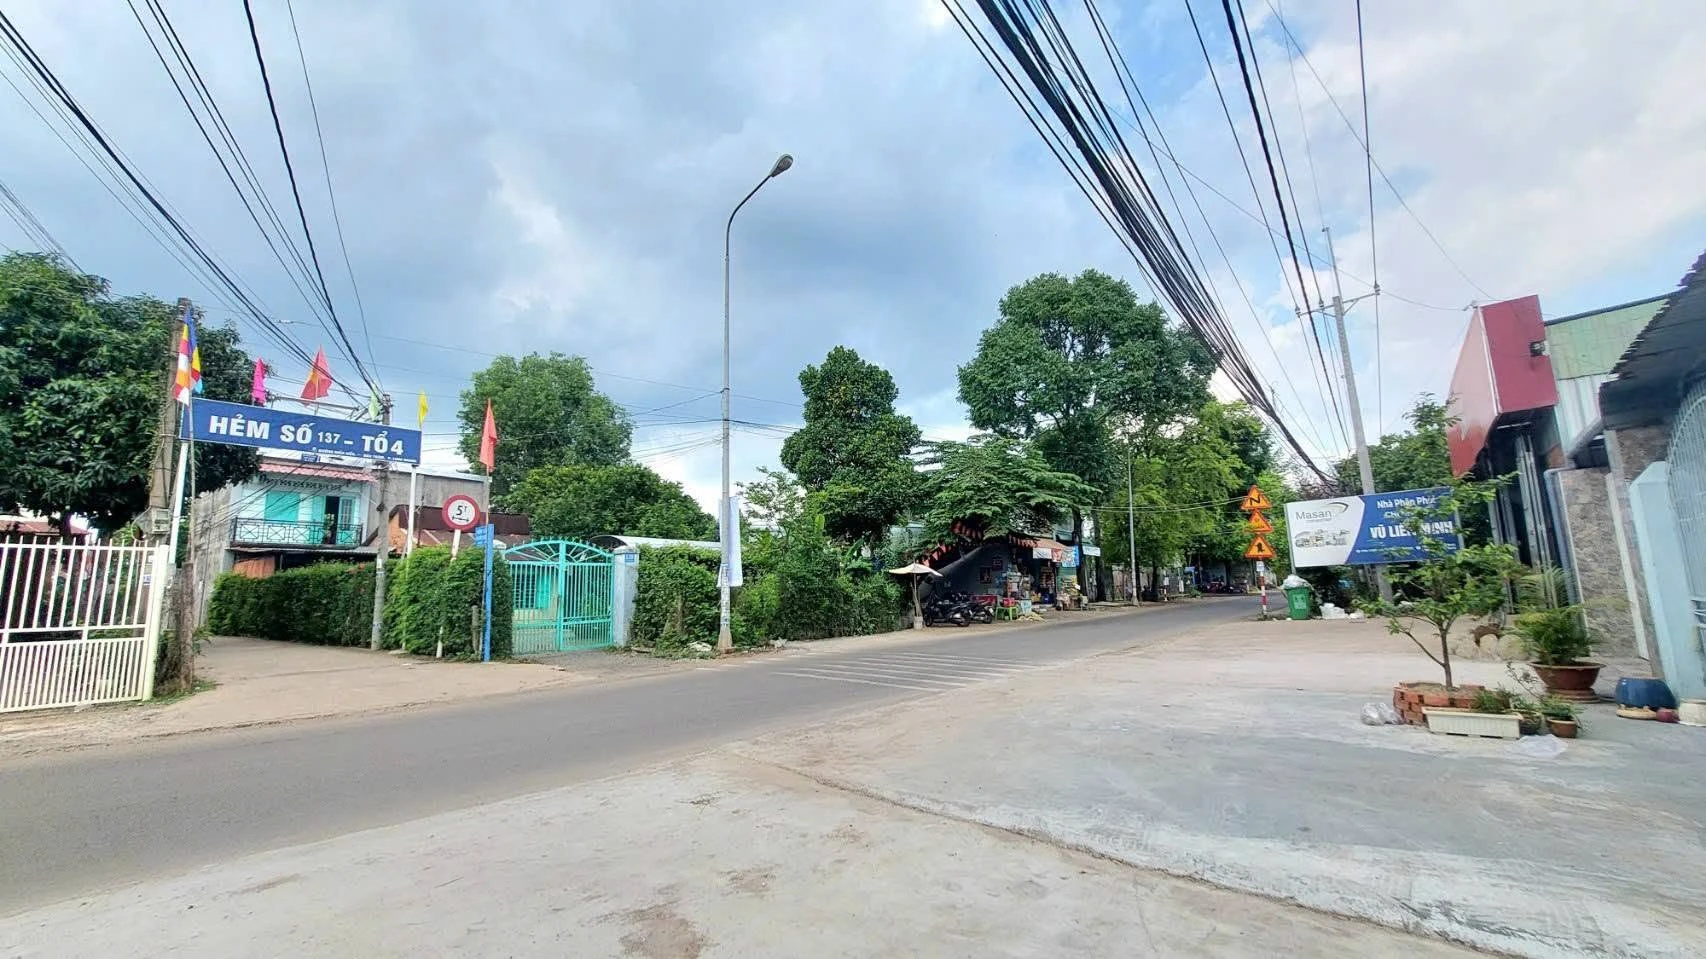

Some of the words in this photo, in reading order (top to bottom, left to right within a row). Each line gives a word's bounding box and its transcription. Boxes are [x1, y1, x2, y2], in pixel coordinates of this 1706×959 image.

[209, 413, 271, 440] HẺM
[280, 422, 315, 444] SỐ
[318, 431, 341, 445] 137
[362, 430, 389, 454] TỔ
[390, 440, 404, 456] 4
[1377, 499, 1393, 509] Nhà
[1295, 510, 1332, 521] Masan
